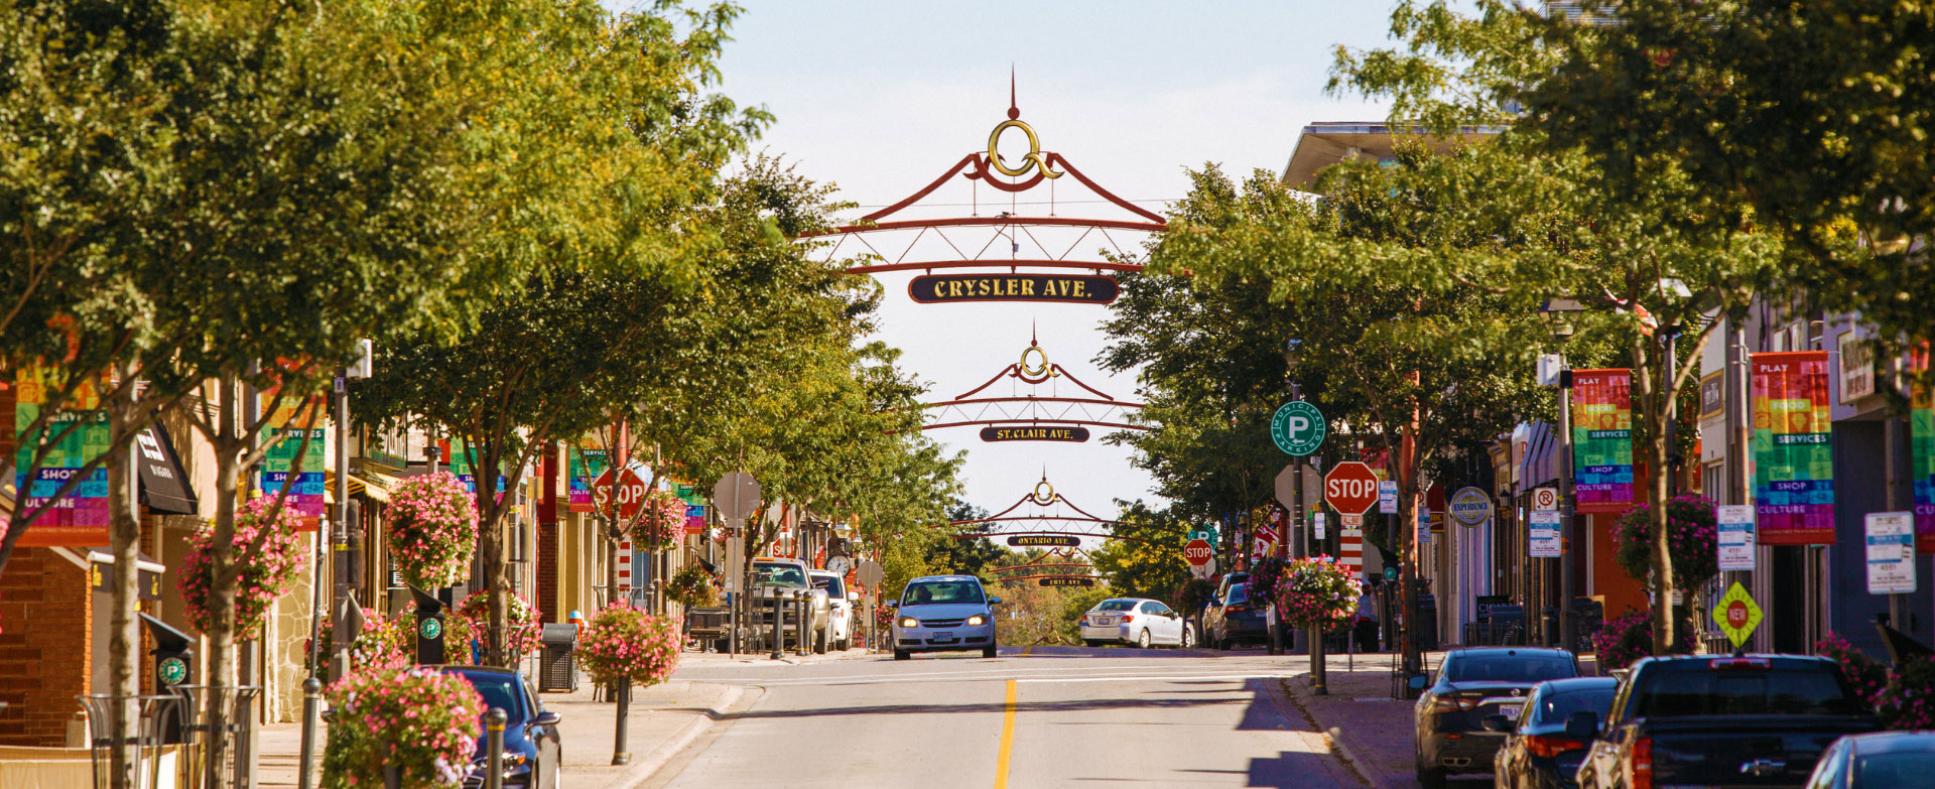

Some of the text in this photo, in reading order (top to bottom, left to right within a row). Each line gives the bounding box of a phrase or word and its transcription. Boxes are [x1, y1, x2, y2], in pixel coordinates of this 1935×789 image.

[987, 119, 1065, 178] Q
[934, 278, 1092, 298] CRYSLER AVE.
[1020, 346, 1060, 377] Q
[1760, 364, 1788, 373] PLAY
[1772, 401, 1805, 410] FOOD
[1274, 402, 1323, 427] MUNICIPAL
[1289, 416, 1309, 439] P
[997, 429, 1073, 439] ST.CLAIR AVE.
[1778, 434, 1827, 444] SERVICES
[1275, 432, 1321, 453] PARKING
[1328, 479, 1375, 498] STOP
[1777, 482, 1807, 491] SHOP
[1758, 505, 1805, 514] CULTURE
[1018, 537, 1052, 545] ONTARIO
[1186, 547, 1211, 559] STOP
